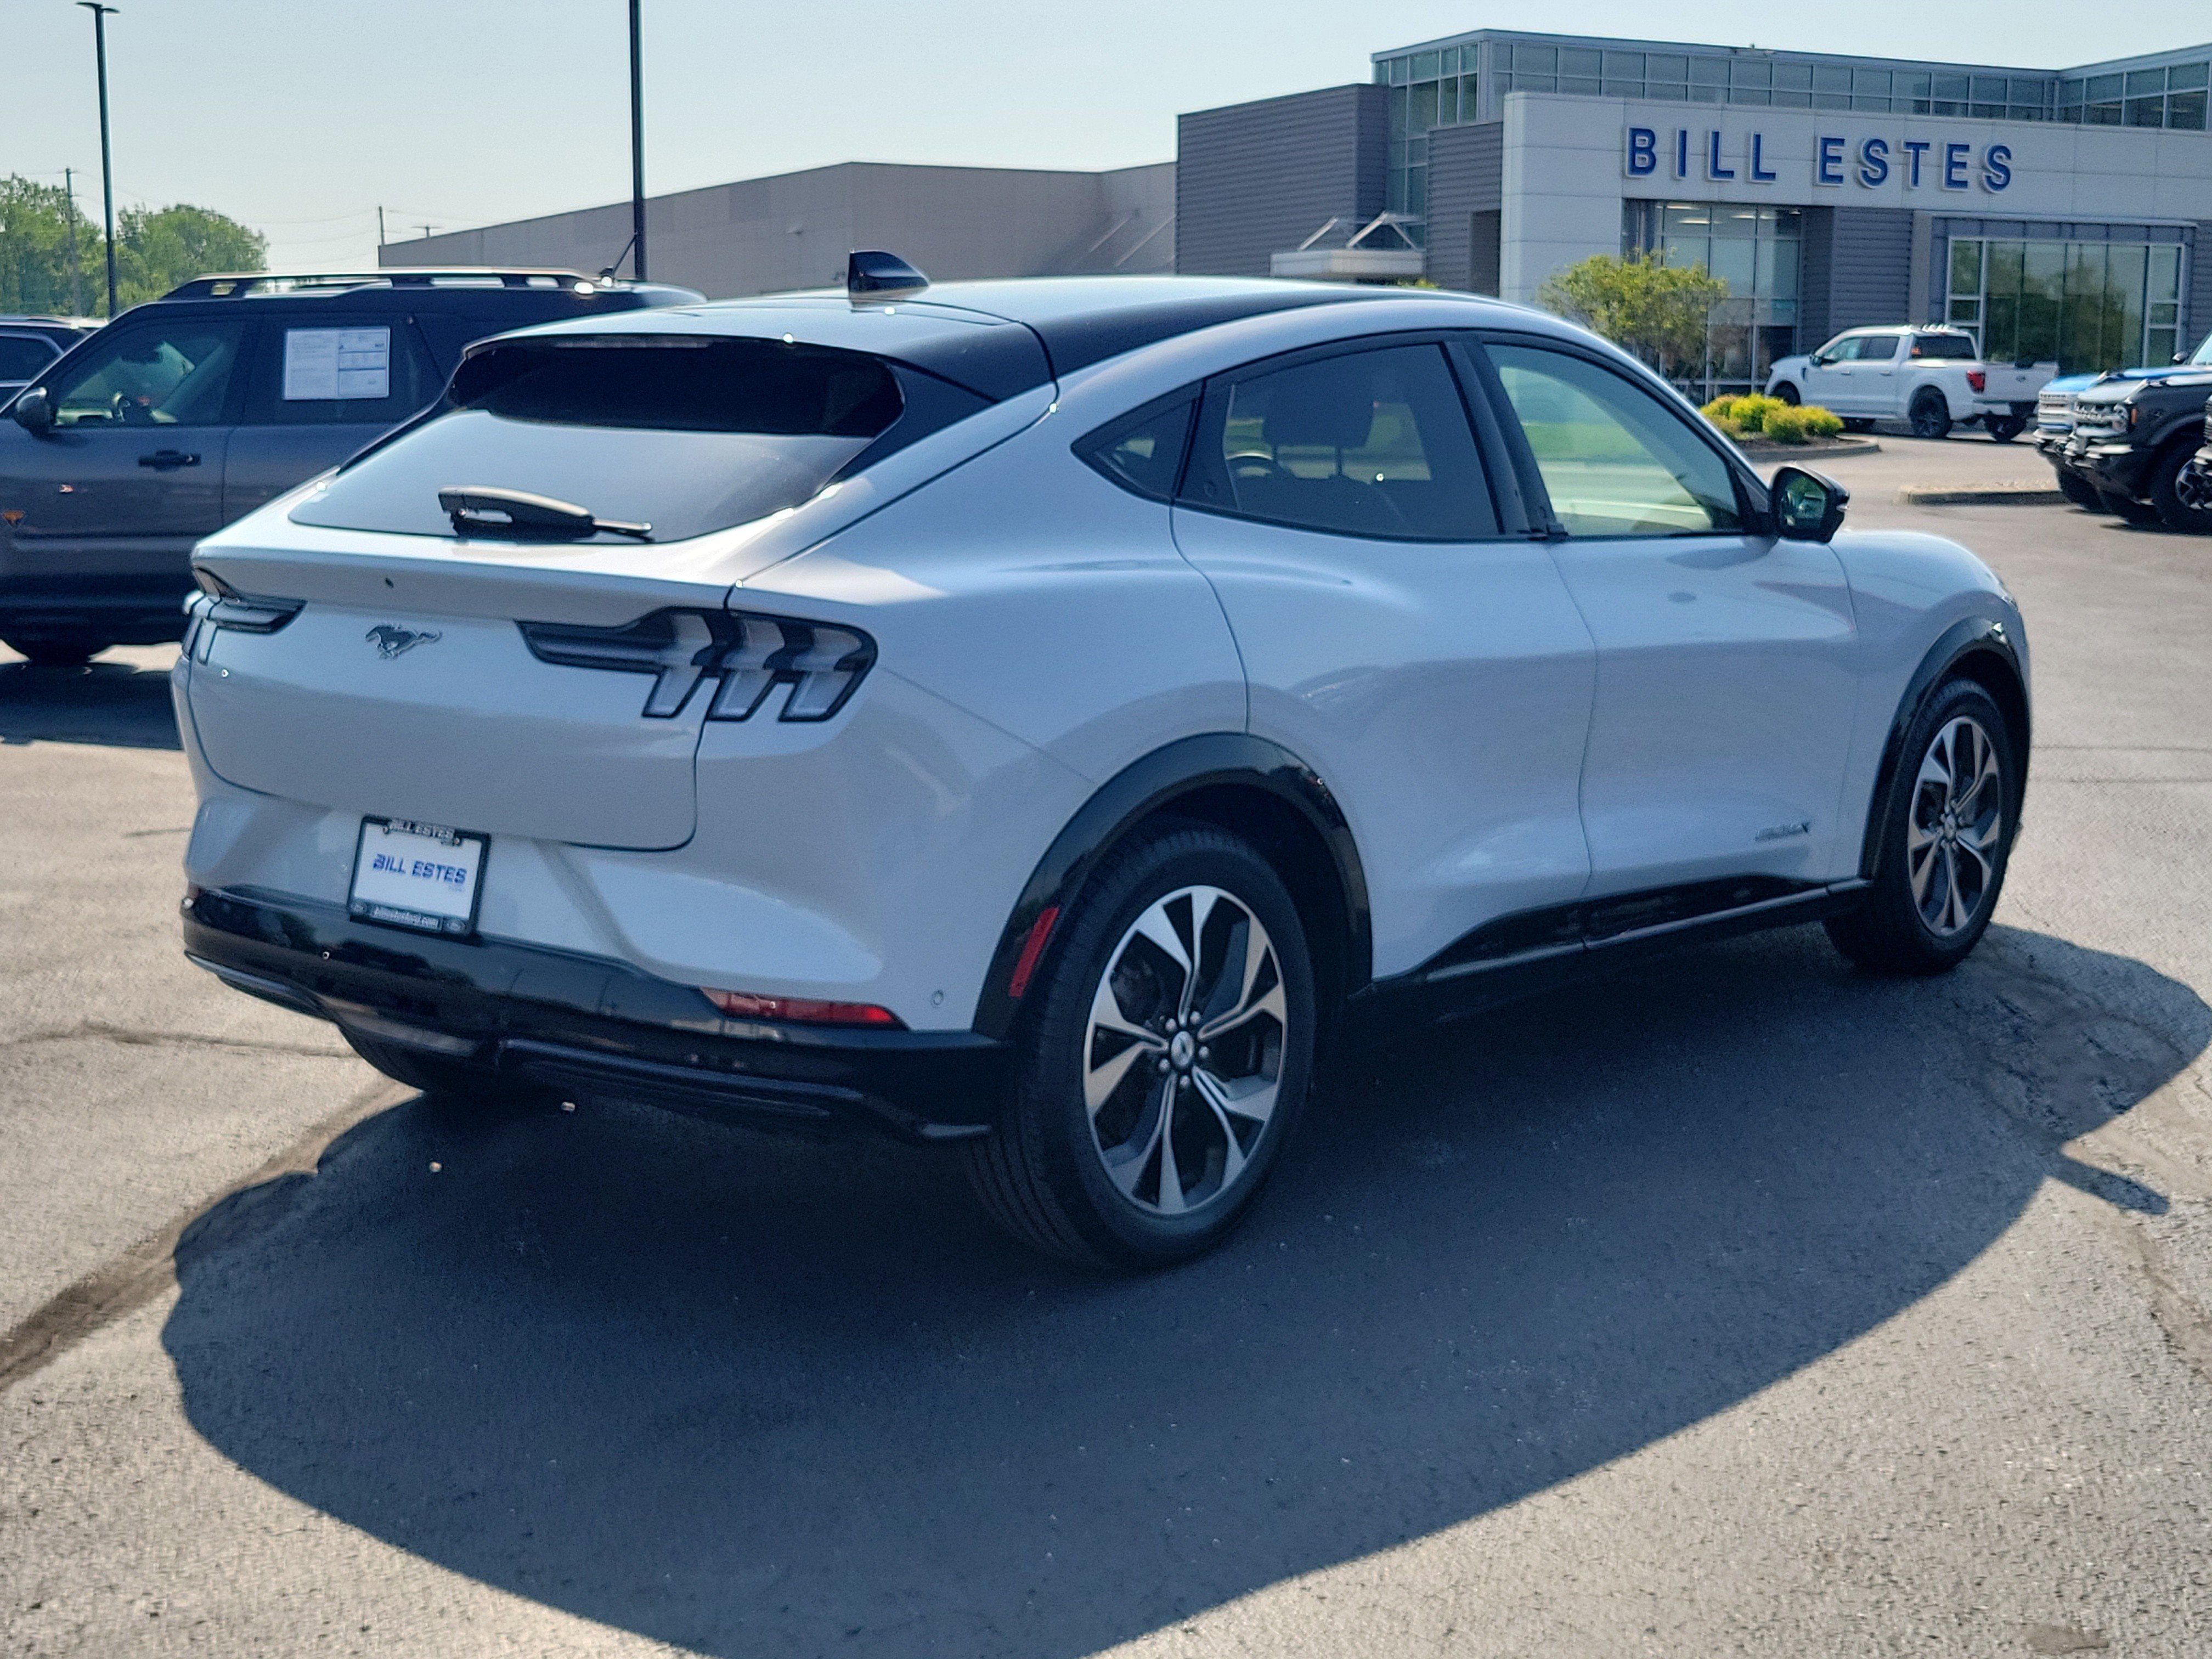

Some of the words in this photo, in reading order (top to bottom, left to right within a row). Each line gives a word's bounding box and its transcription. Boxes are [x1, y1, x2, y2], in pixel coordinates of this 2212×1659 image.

[1627, 127, 1776, 182] BILL
[1816, 136, 2013, 193] ESTES
[373, 854, 406, 873] BILL
[412, 861, 467, 884] ESTES
